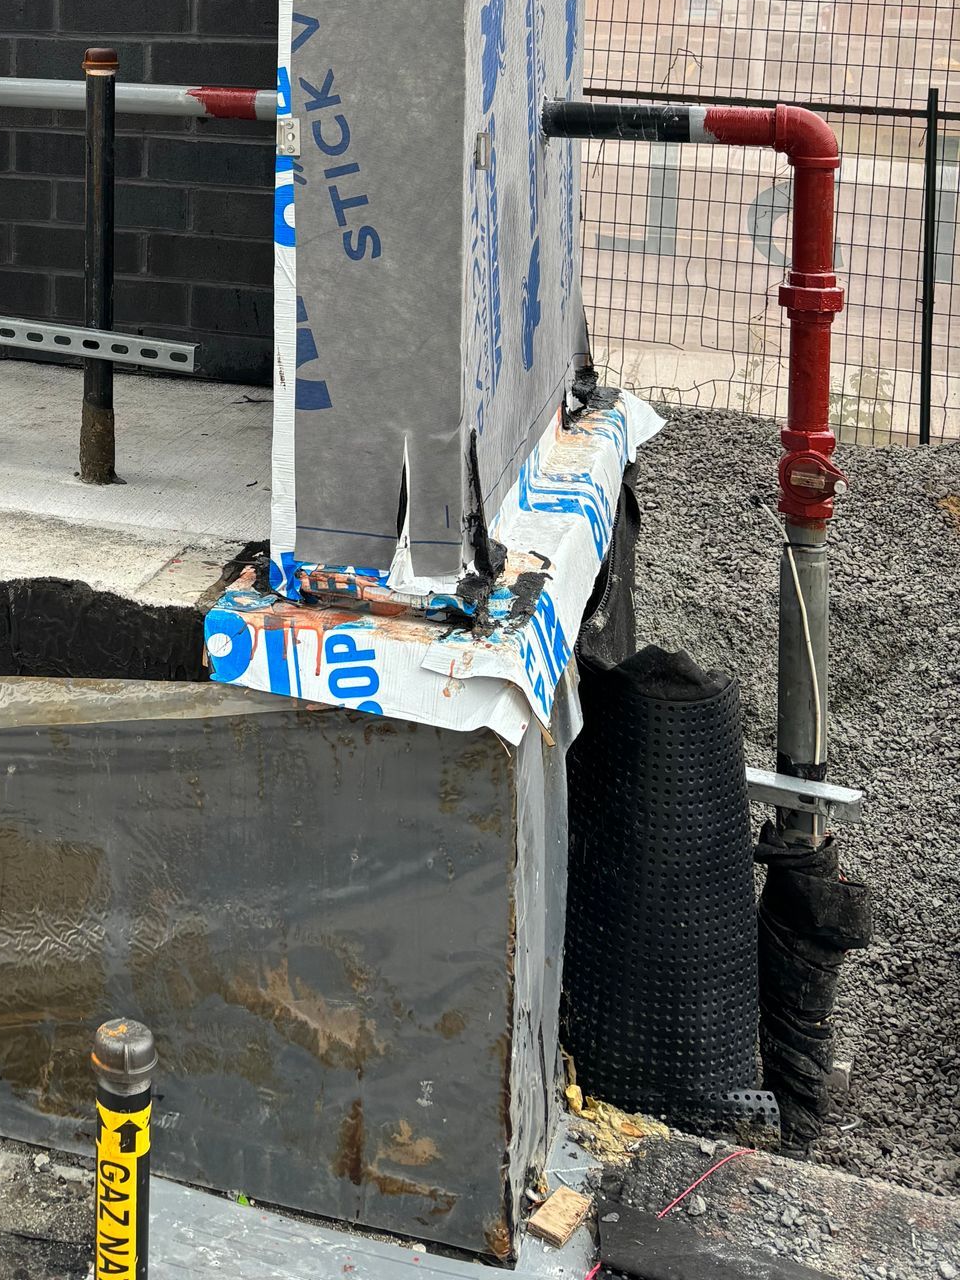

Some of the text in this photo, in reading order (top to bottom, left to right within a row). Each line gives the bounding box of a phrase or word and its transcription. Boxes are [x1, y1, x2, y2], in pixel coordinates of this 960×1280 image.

[298, 68, 382, 261] STICK
[99, 1159, 131, 1280] GAZ NA
